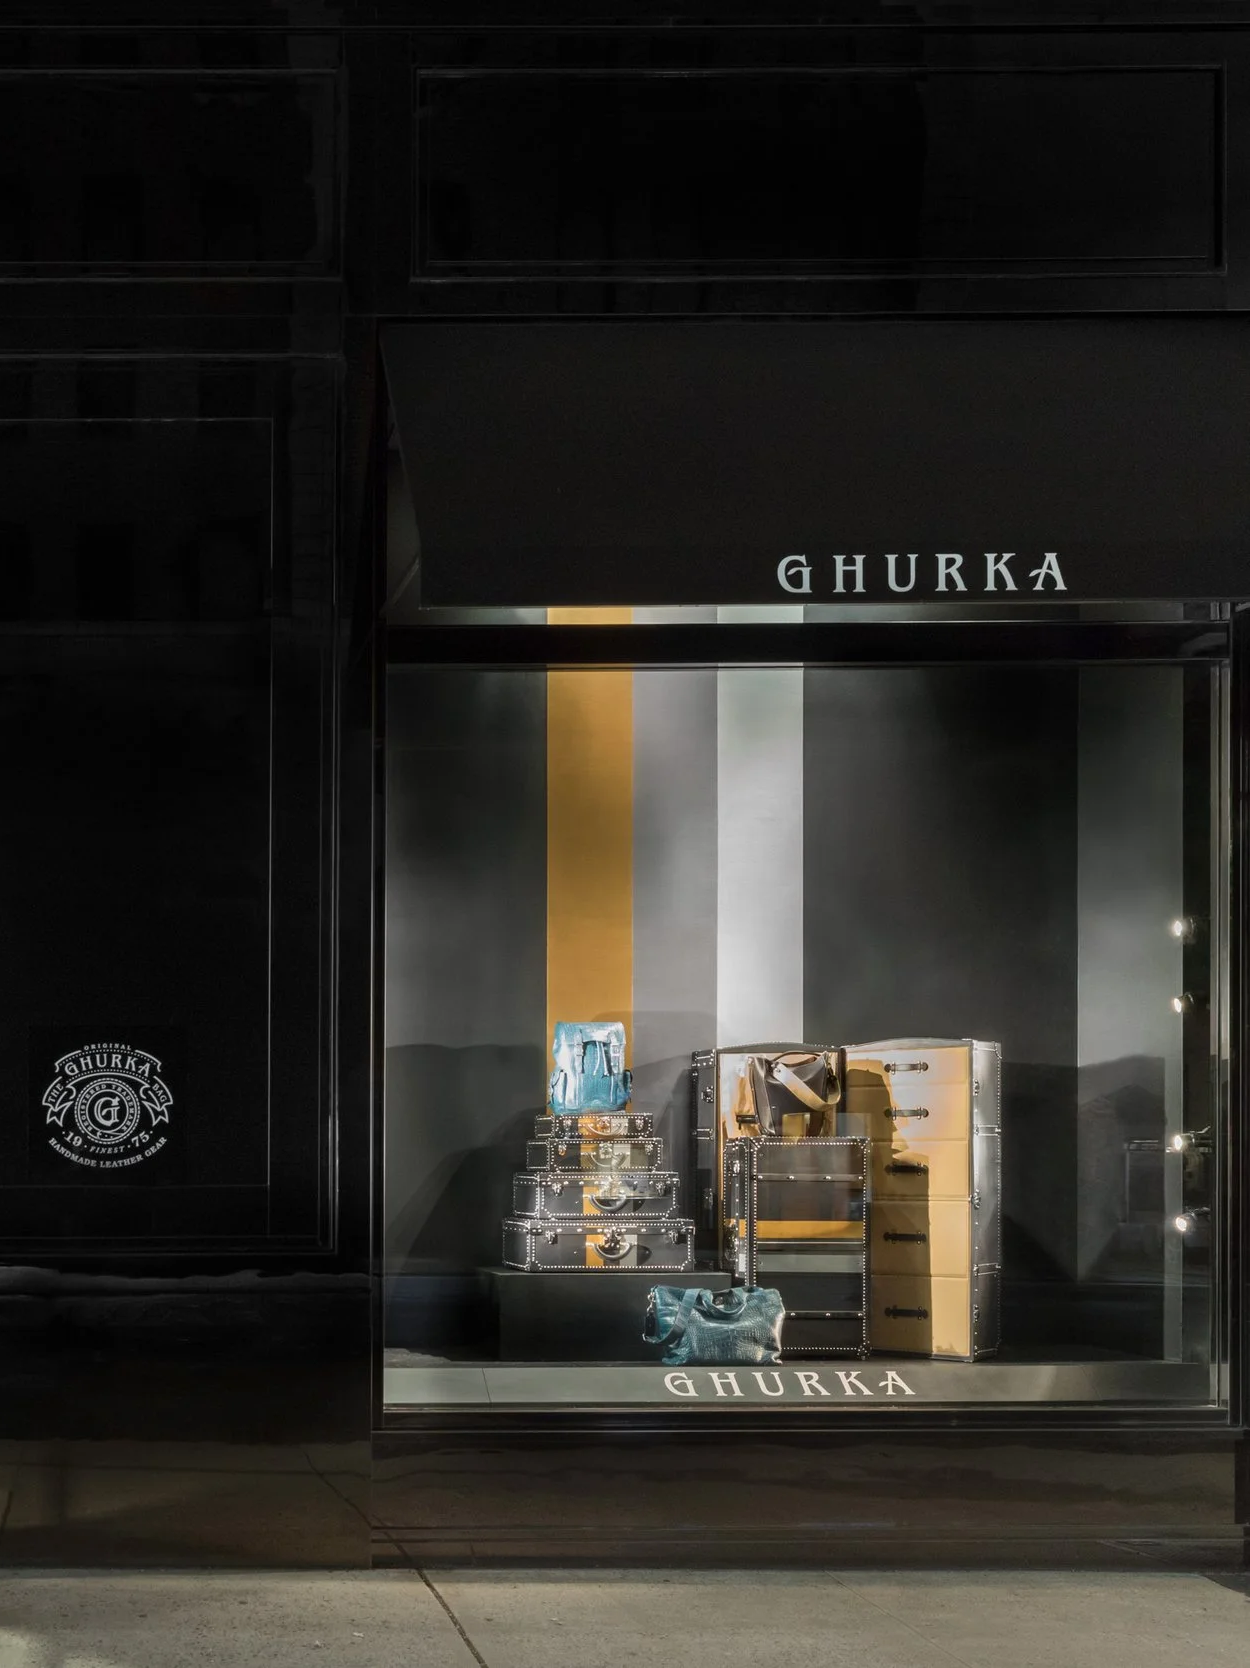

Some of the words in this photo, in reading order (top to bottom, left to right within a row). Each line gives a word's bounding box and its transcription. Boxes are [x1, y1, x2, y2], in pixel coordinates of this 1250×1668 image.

[777, 553, 1068, 594] GHURKA
[83, 1043, 131, 1051] ORIGINAL
[64, 1053, 151, 1077] GHURKA
[48, 1082, 64, 1103] THE
[152, 1083, 167, 1103] BAG
[80, 1084, 107, 1132] REGISTERED
[111, 1084, 135, 1132] TRADEMARK
[48, 1137, 97, 1167] HANDMADE
[100, 1154, 144, 1168] LEATHER
[144, 1136, 168, 1158] GEAR
[63, 1131, 83, 1147] 19
[89, 1145, 125, 1154] FINEST
[131, 1131, 150, 1147] 75
[664, 1371, 916, 1397] GHURKA
